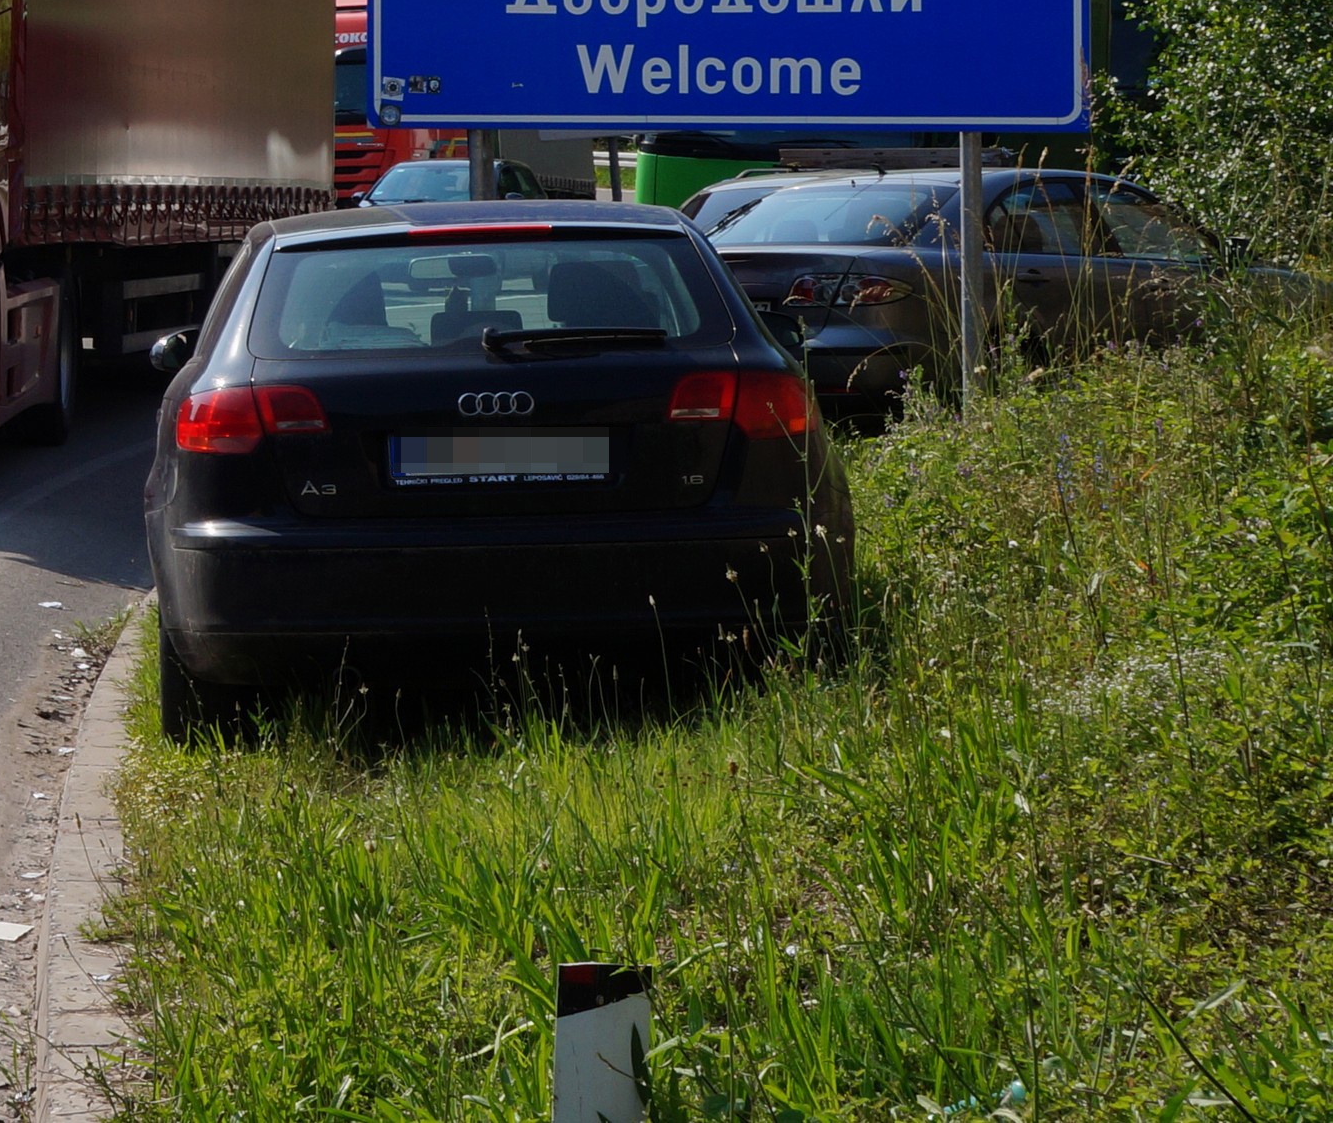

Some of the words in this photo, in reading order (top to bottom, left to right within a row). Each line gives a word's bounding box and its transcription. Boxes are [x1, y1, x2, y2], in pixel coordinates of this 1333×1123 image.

[576, 44, 861, 96] Welcome
[468, 474, 518, 483] START
[300, 480, 337, 496] A3
